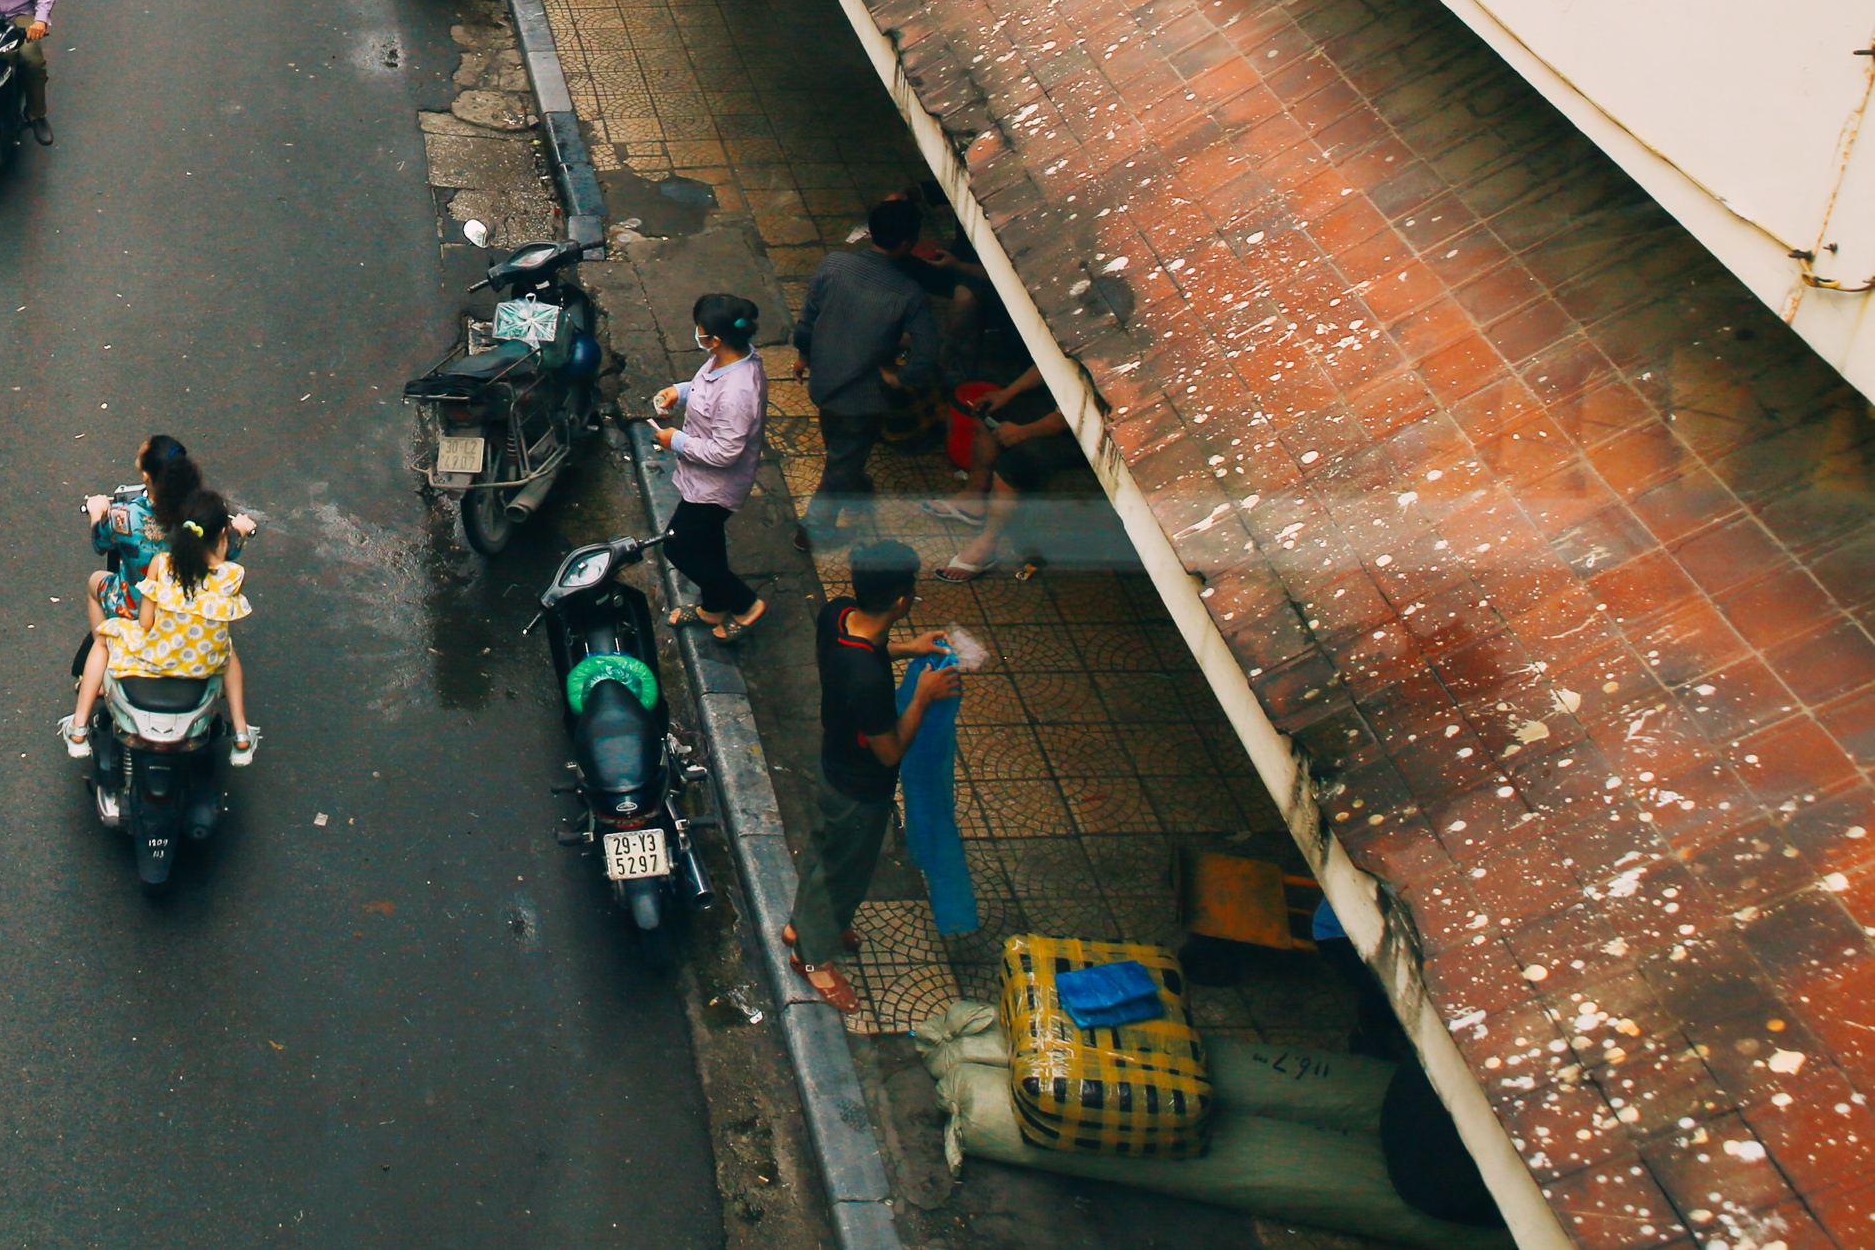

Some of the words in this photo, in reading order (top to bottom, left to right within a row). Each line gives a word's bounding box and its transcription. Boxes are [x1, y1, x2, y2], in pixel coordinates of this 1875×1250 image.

[445, 440, 477, 454] 30-L2
[613, 834, 657, 856] 29-Y3
[616, 854, 657, 875] 5297
